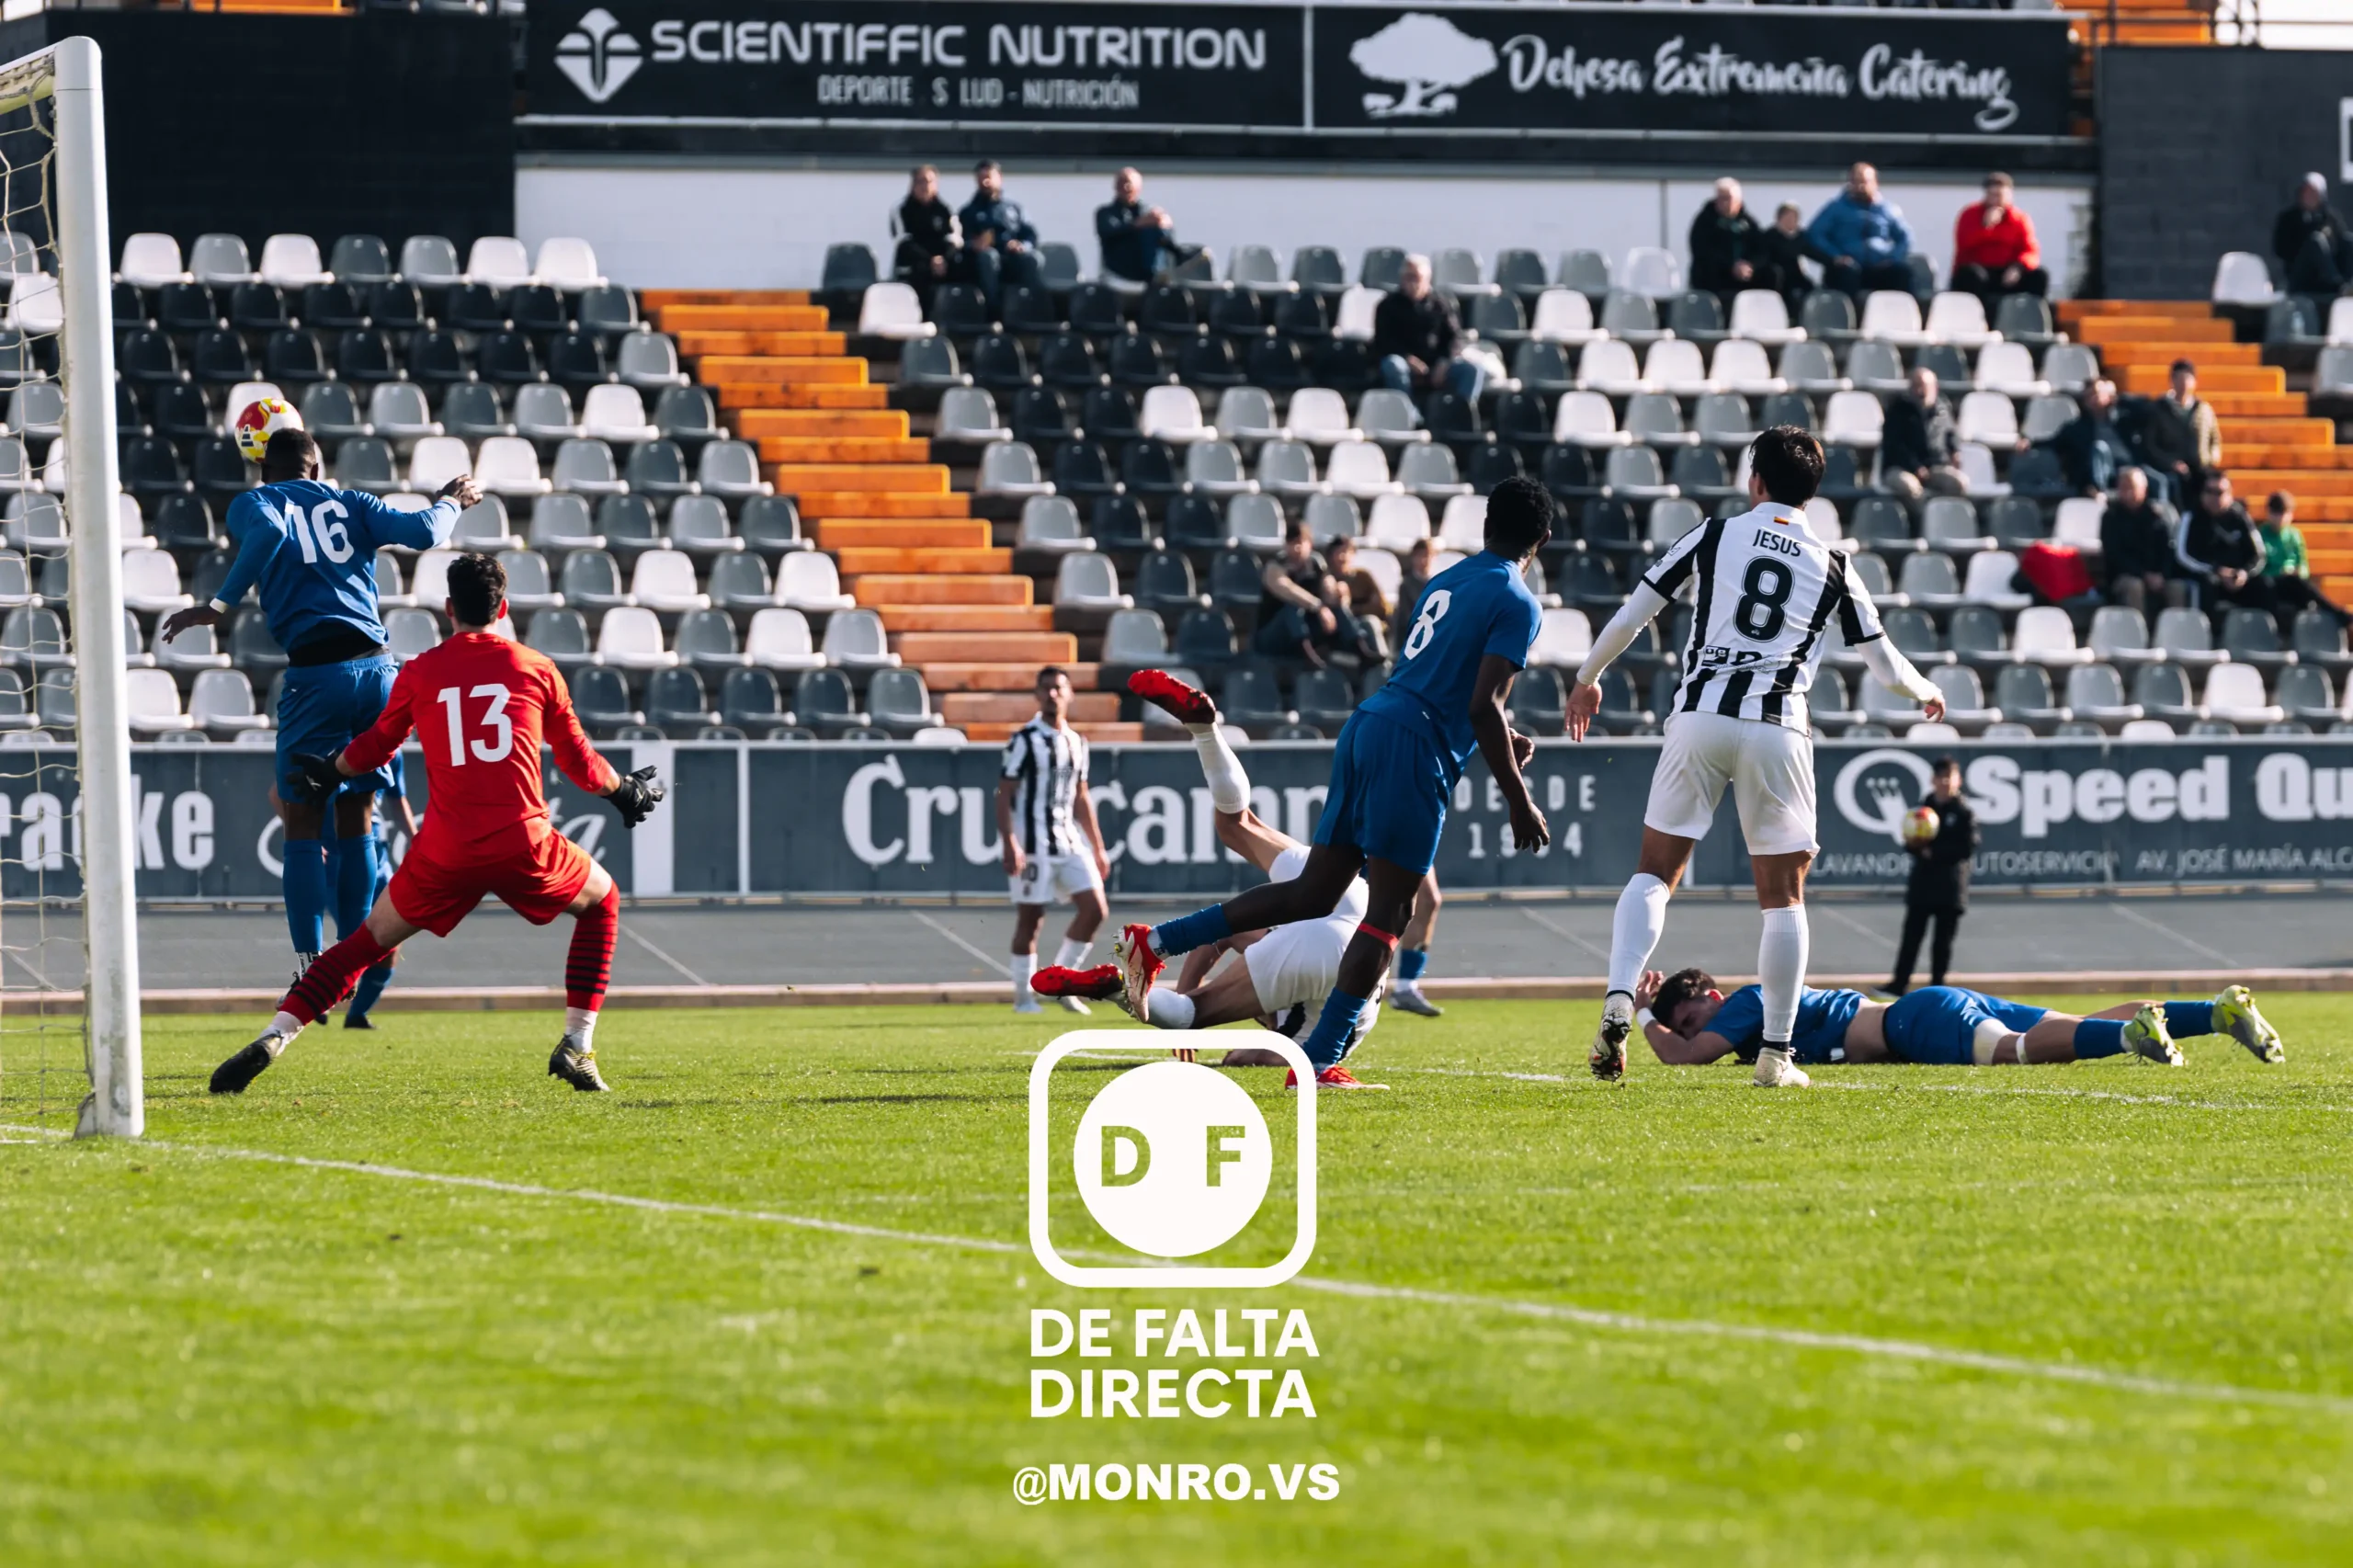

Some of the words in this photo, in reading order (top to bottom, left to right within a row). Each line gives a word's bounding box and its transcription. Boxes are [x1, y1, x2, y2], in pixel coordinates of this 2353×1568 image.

[652, 20, 966, 65] SCIENTIFFIC
[989, 24, 1266, 70] NUTRITION
[817, 74, 914, 107] DEPORTE
[1022, 73, 1140, 108] NUTRICIÓN
[1501, 34, 1645, 99] Dehesa
[1859, 42, 2019, 131] Catering
[285, 499, 355, 564] 16
[1752, 528, 1802, 557] JESUS
[1404, 589, 1452, 660] 8
[1733, 555, 1795, 642] 8
[437, 683, 514, 767] 13
[0, 774, 214, 871] ake
[1454, 775, 1597, 812] DEDE
[1966, 755, 2230, 837] Speed
[2176, 843, 2228, 877] JOSÉ
[2233, 842, 2306, 871] MARÍA
